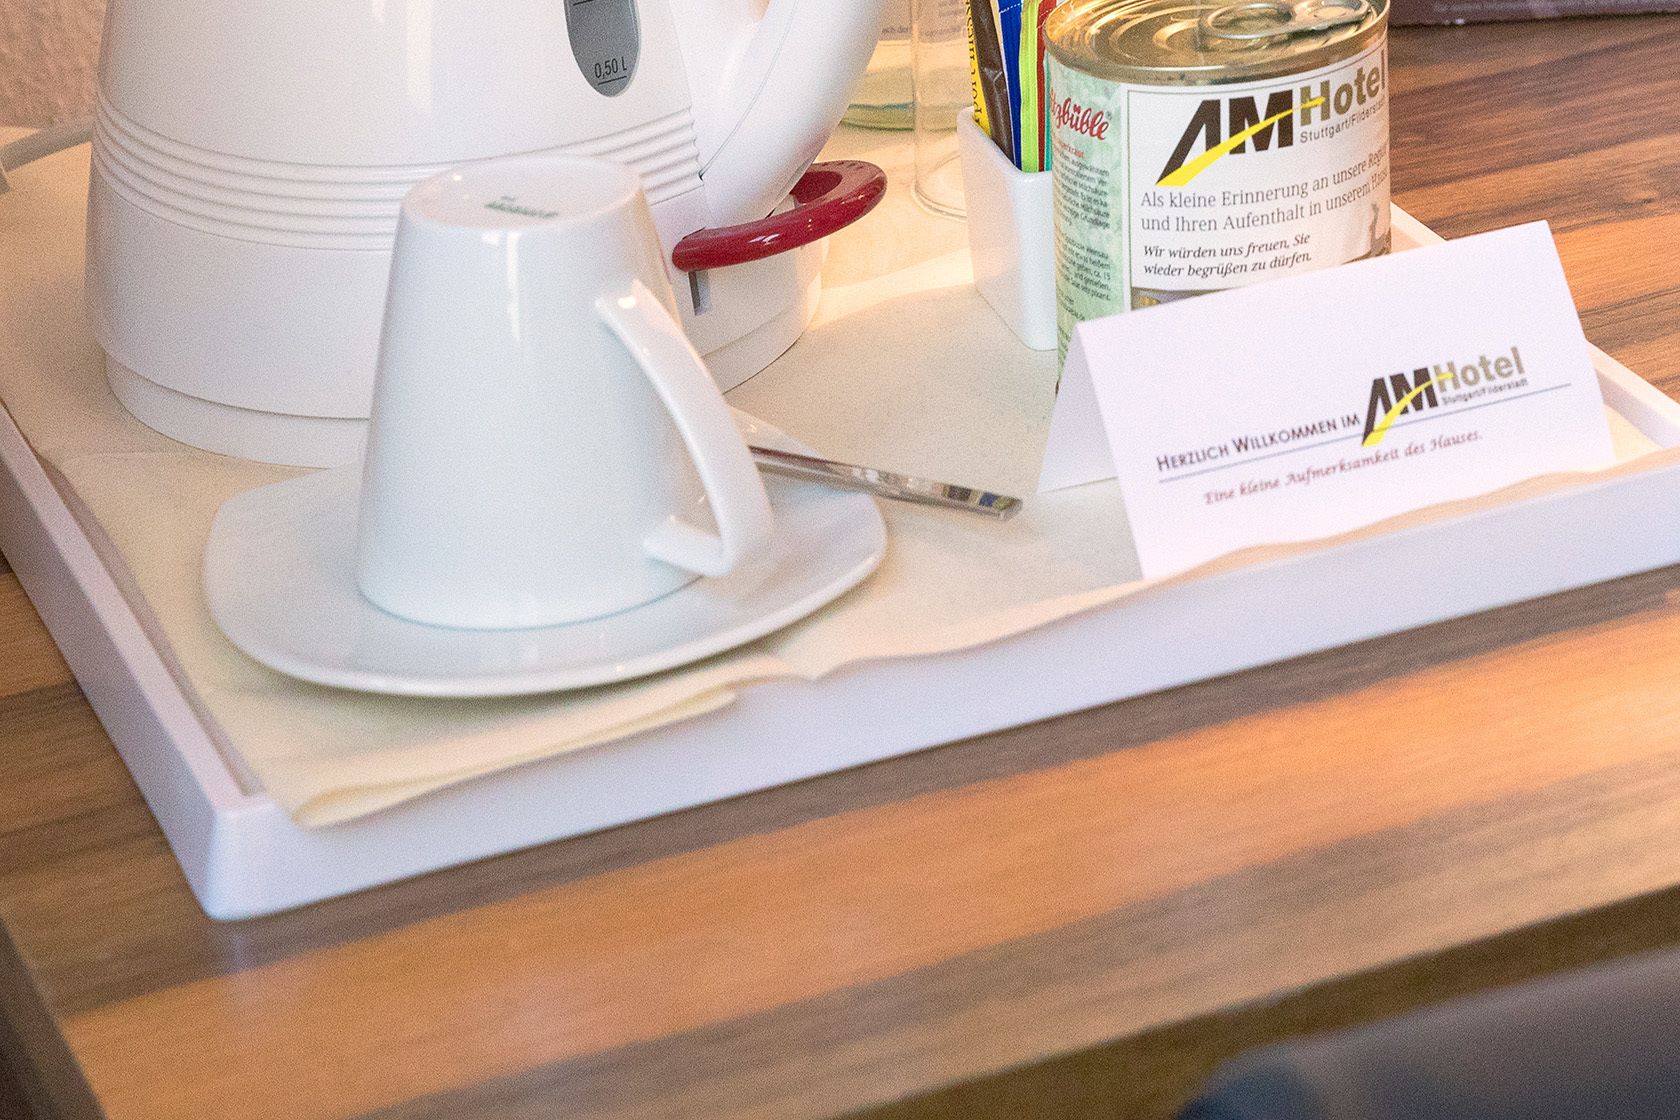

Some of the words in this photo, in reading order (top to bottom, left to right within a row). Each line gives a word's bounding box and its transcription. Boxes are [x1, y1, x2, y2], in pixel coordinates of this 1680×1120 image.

[594, 58, 619, 80] 0,50
[1155, 88, 1294, 186] AM
[1299, 52, 1387, 126] Hotel
[1140, 191, 1165, 209] Als
[1169, 190, 1217, 210] kleine
[1221, 180, 1310, 208] Erinnerung
[1312, 176, 1331, 193] an
[1332, 163, 1368, 190] unsere
[1141, 214, 1171, 232] und
[1175, 213, 1218, 232] Ihren
[1223, 203, 1305, 231] Aufenthalt
[1308, 200, 1323, 218] in
[1325, 182, 1371, 214] unserem
[1143, 244, 1165, 258] Wir
[1167, 242, 1217, 259] würden
[1219, 244, 1245, 258] uns
[1245, 237, 1291, 262] freuen,
[1293, 233, 1311, 248] Sie
[1143, 262, 1184, 277] wieder
[1187, 260, 1248, 281] begrüßen
[1251, 261, 1267, 272] zu
[1269, 251, 1312, 274] dürfen.
[1361, 367, 1438, 447] AM
[1432, 346, 1525, 394] Hotel
[1156, 443, 1229, 472] HERZLICH
[1231, 419, 1337, 454] WILLKOMMEN
[1341, 412, 1361, 429] IM
[1204, 487, 1235, 505] Eine
[1239, 477, 1281, 496] kleine
[1286, 448, 1400, 489] Aufmerksamkeit
[1404, 441, 1426, 458] des
[1430, 429, 1484, 453] Hauses.
